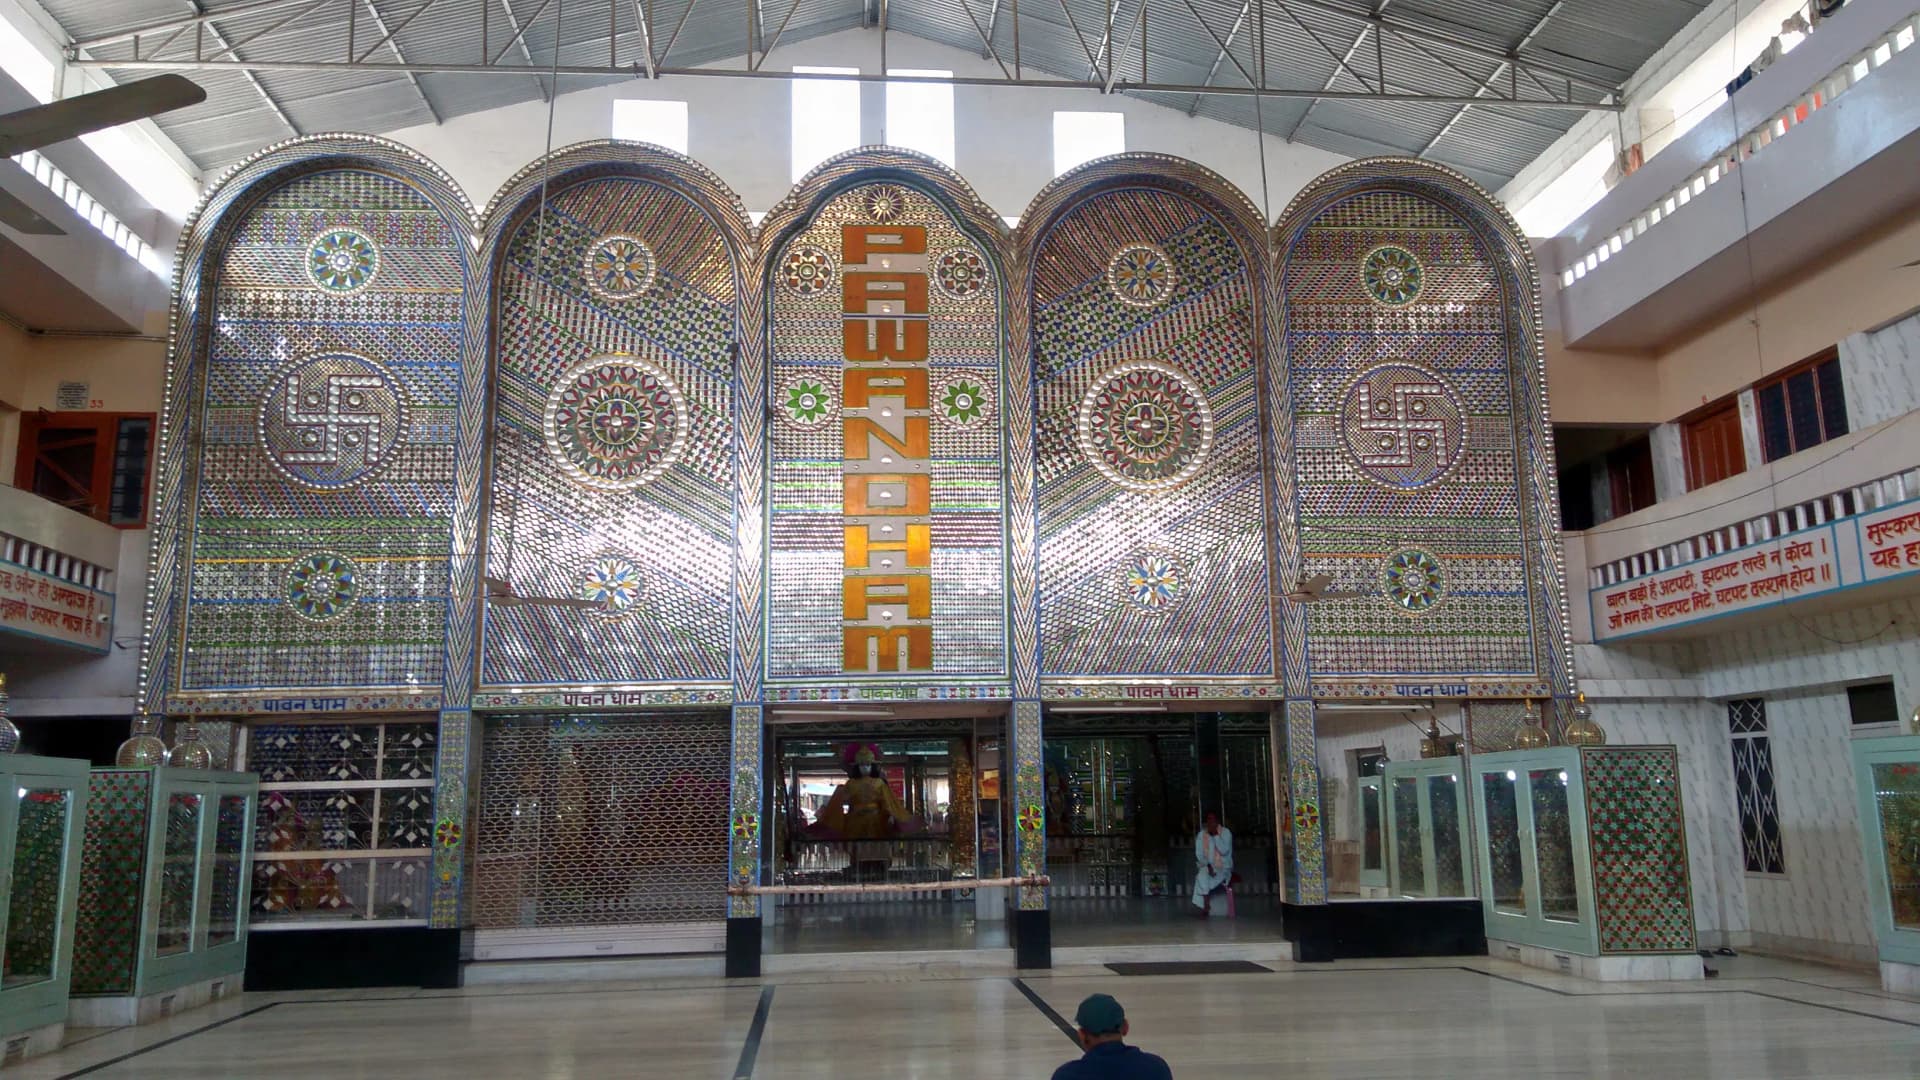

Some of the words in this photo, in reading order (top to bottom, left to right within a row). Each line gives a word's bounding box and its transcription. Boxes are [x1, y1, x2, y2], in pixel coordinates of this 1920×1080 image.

[1870, 547, 1900, 568] यह
[1606, 592, 1627, 608] बात
[1648, 578, 1657, 600] है
[1701, 561, 1739, 586] झटपट
[1769, 550, 1782, 566] न
[1784, 541, 1813, 562] कोय
[1608, 611, 1622, 629] जो
[1656, 599, 1691, 618] खटपट
[1127, 686, 1165, 699] पावन
[1168, 686, 1200, 699] धाम
[1396, 684, 1435, 697] पावन
[1439, 684, 1469, 697] धाम
[263, 699, 306, 712] पावन
[310, 698, 347, 711] धाम
[563, 693, 605, 706] पावन
[611, 692, 642, 705] धाम
